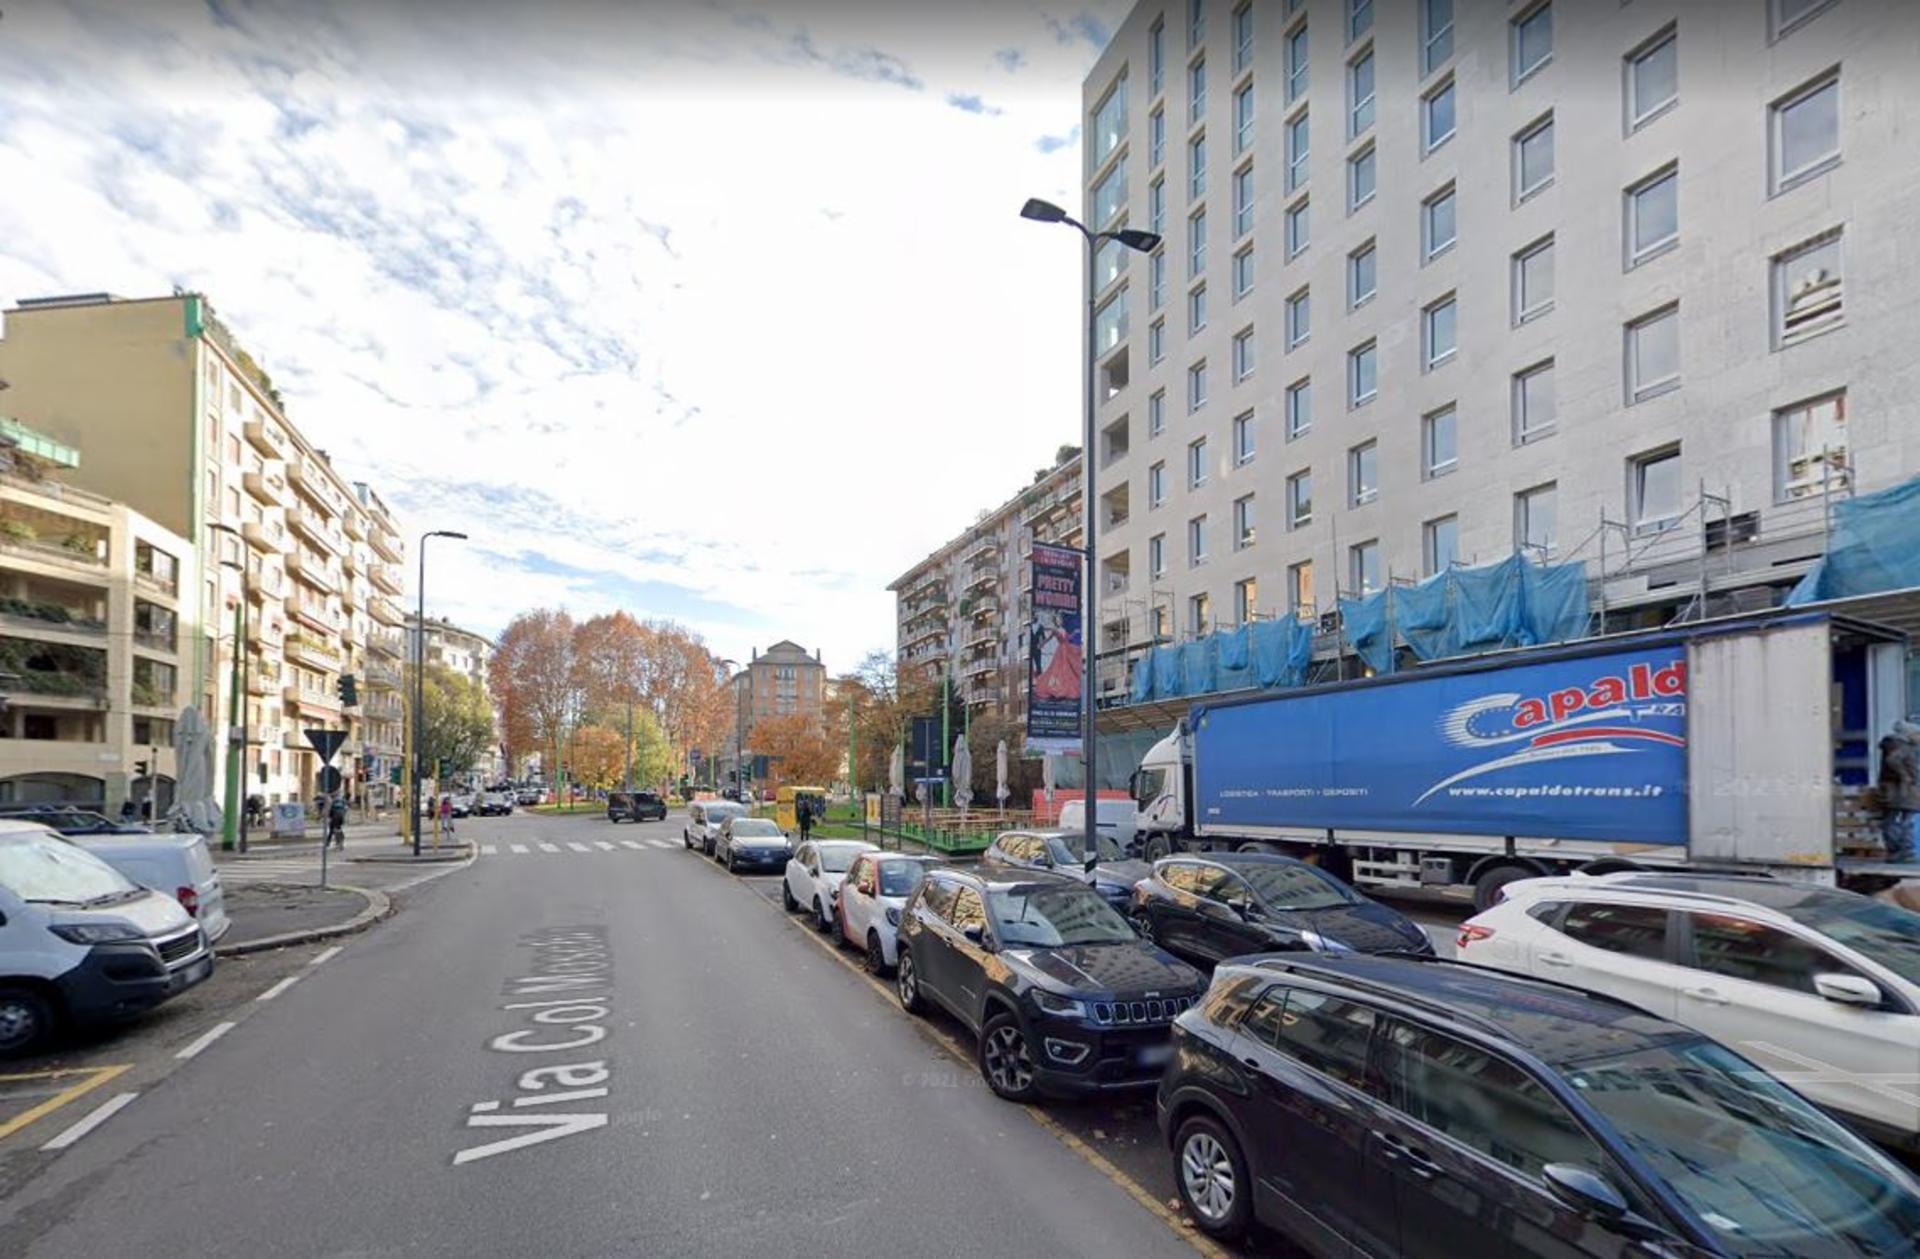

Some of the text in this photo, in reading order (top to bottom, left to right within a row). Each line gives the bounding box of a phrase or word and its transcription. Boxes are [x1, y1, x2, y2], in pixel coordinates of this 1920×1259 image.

[1037, 574, 1075, 593] PRETTY
[1323, 787, 1369, 796] DEPOSITI
[1448, 784, 1663, 798] www.capaldotrans.it
